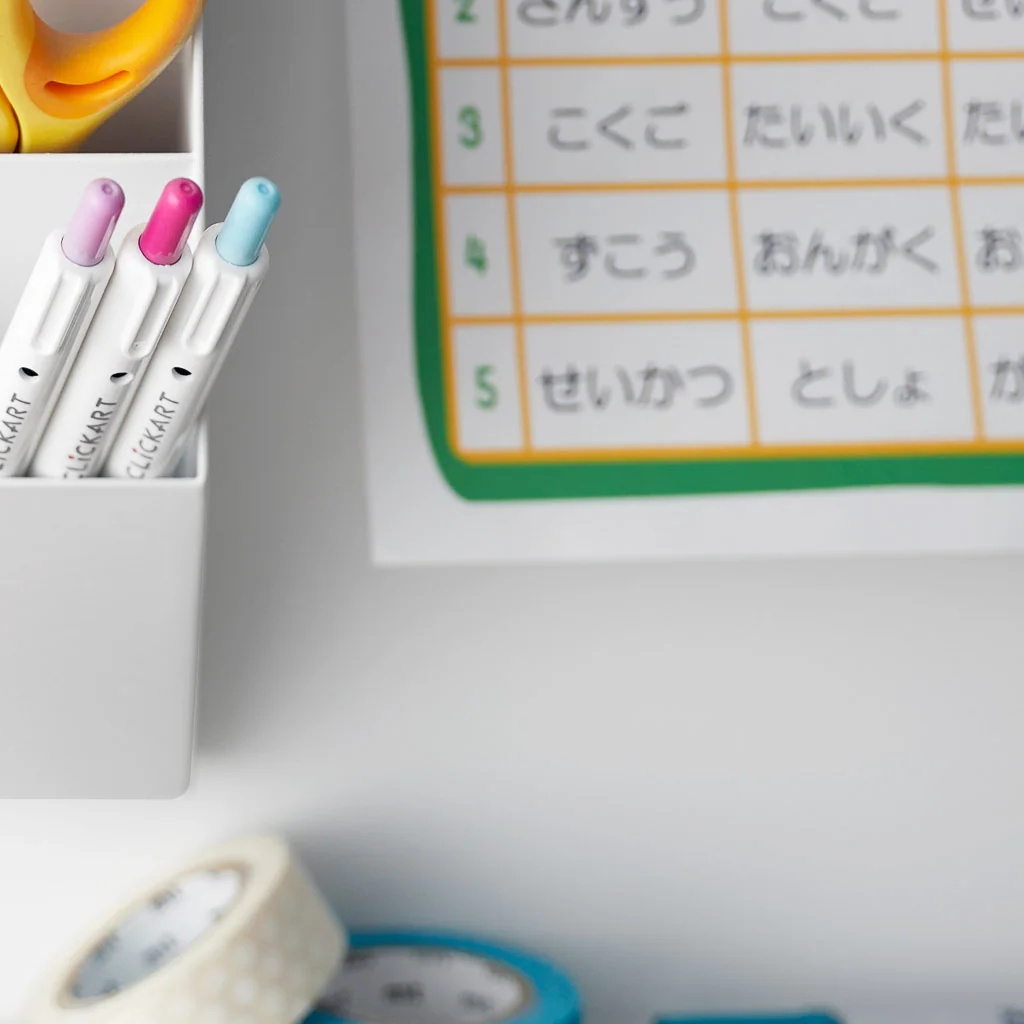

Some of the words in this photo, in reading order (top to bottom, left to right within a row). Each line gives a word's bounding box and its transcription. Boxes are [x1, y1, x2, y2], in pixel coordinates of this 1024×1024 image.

[457, 105, 484, 150] 3
[546, 103, 692, 151] こくご
[742, 98, 929, 149] たいいく
[463, 235, 489, 276] 4
[752, 225, 940, 275] おんがく
[473, 364, 499, 411] 5
[536, 363, 736, 414] せいかつ
[789, 359, 932, 407] としょ
[63, 397, 117, 479] LiCKART
